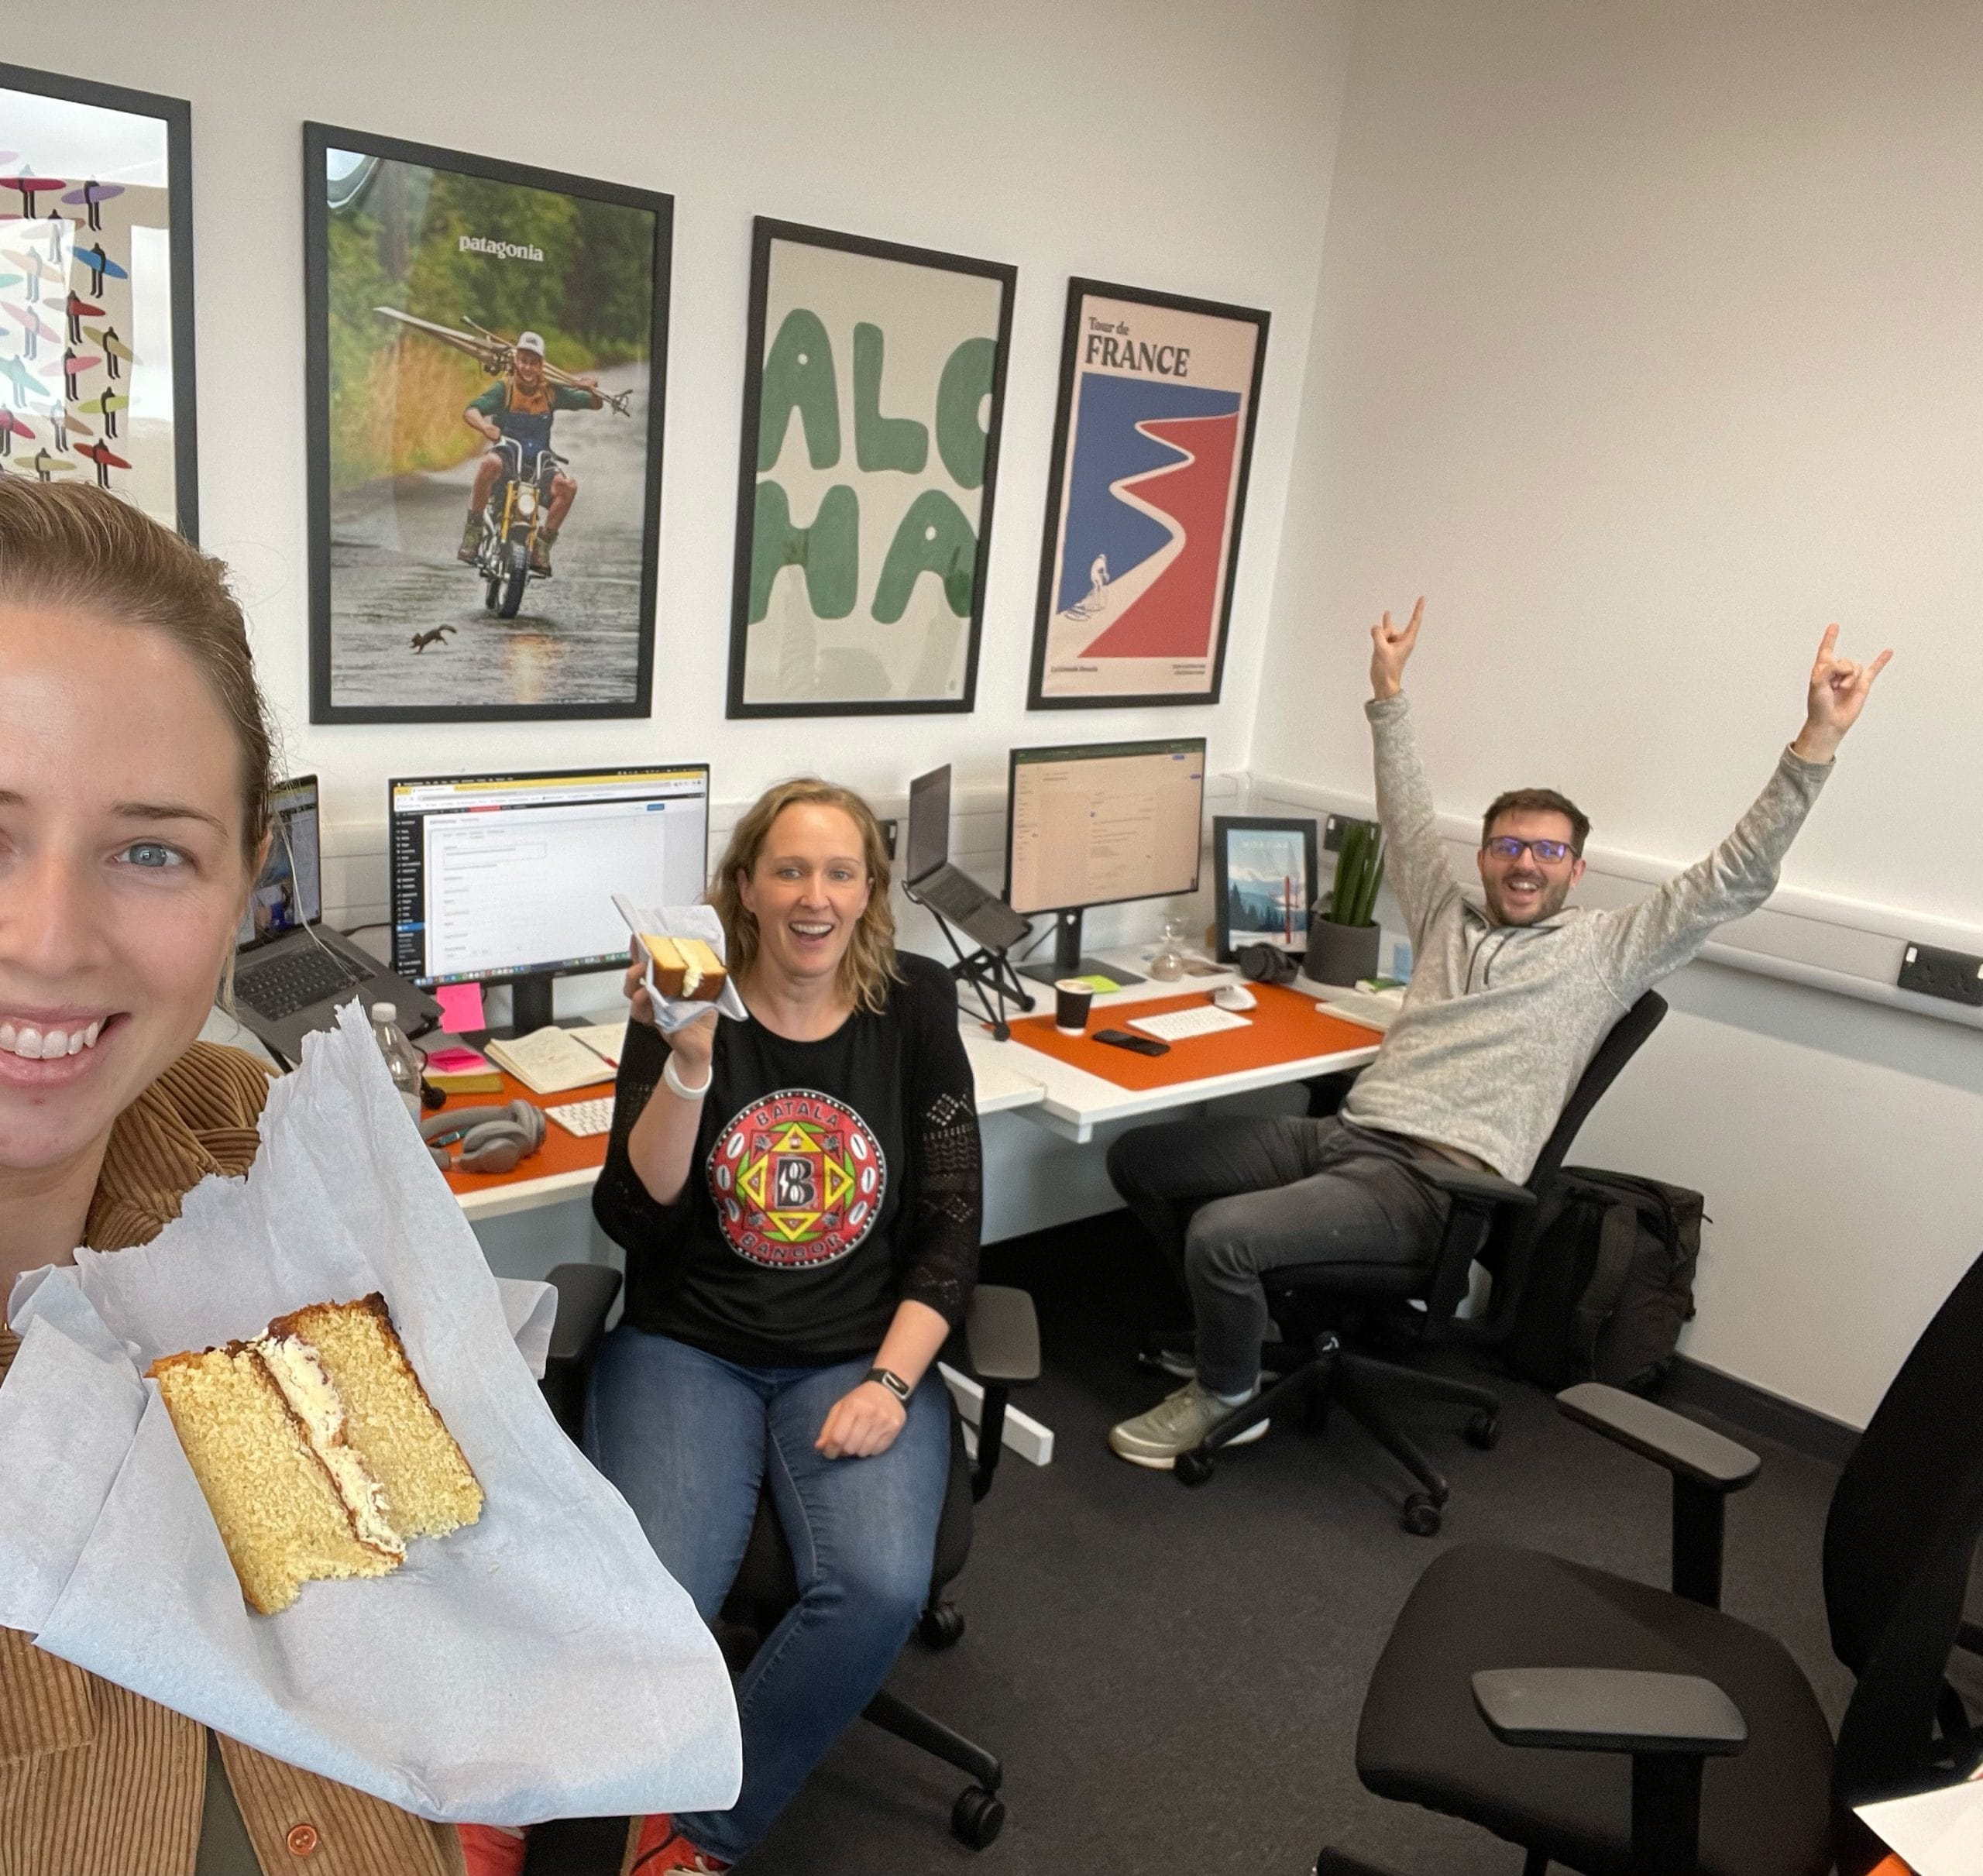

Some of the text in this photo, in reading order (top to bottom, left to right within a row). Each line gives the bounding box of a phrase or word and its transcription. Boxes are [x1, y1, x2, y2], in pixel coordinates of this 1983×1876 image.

[459, 235, 544, 262] patagonia
[1089, 316, 1129, 335] Tour de
[1085, 334, 1190, 376] FRANCE
[748, 479, 978, 624] HA
[755, 1102, 838, 1127] BATALA
[775, 1156, 816, 1209] B
[740, 1232, 844, 1258] BANGOR
